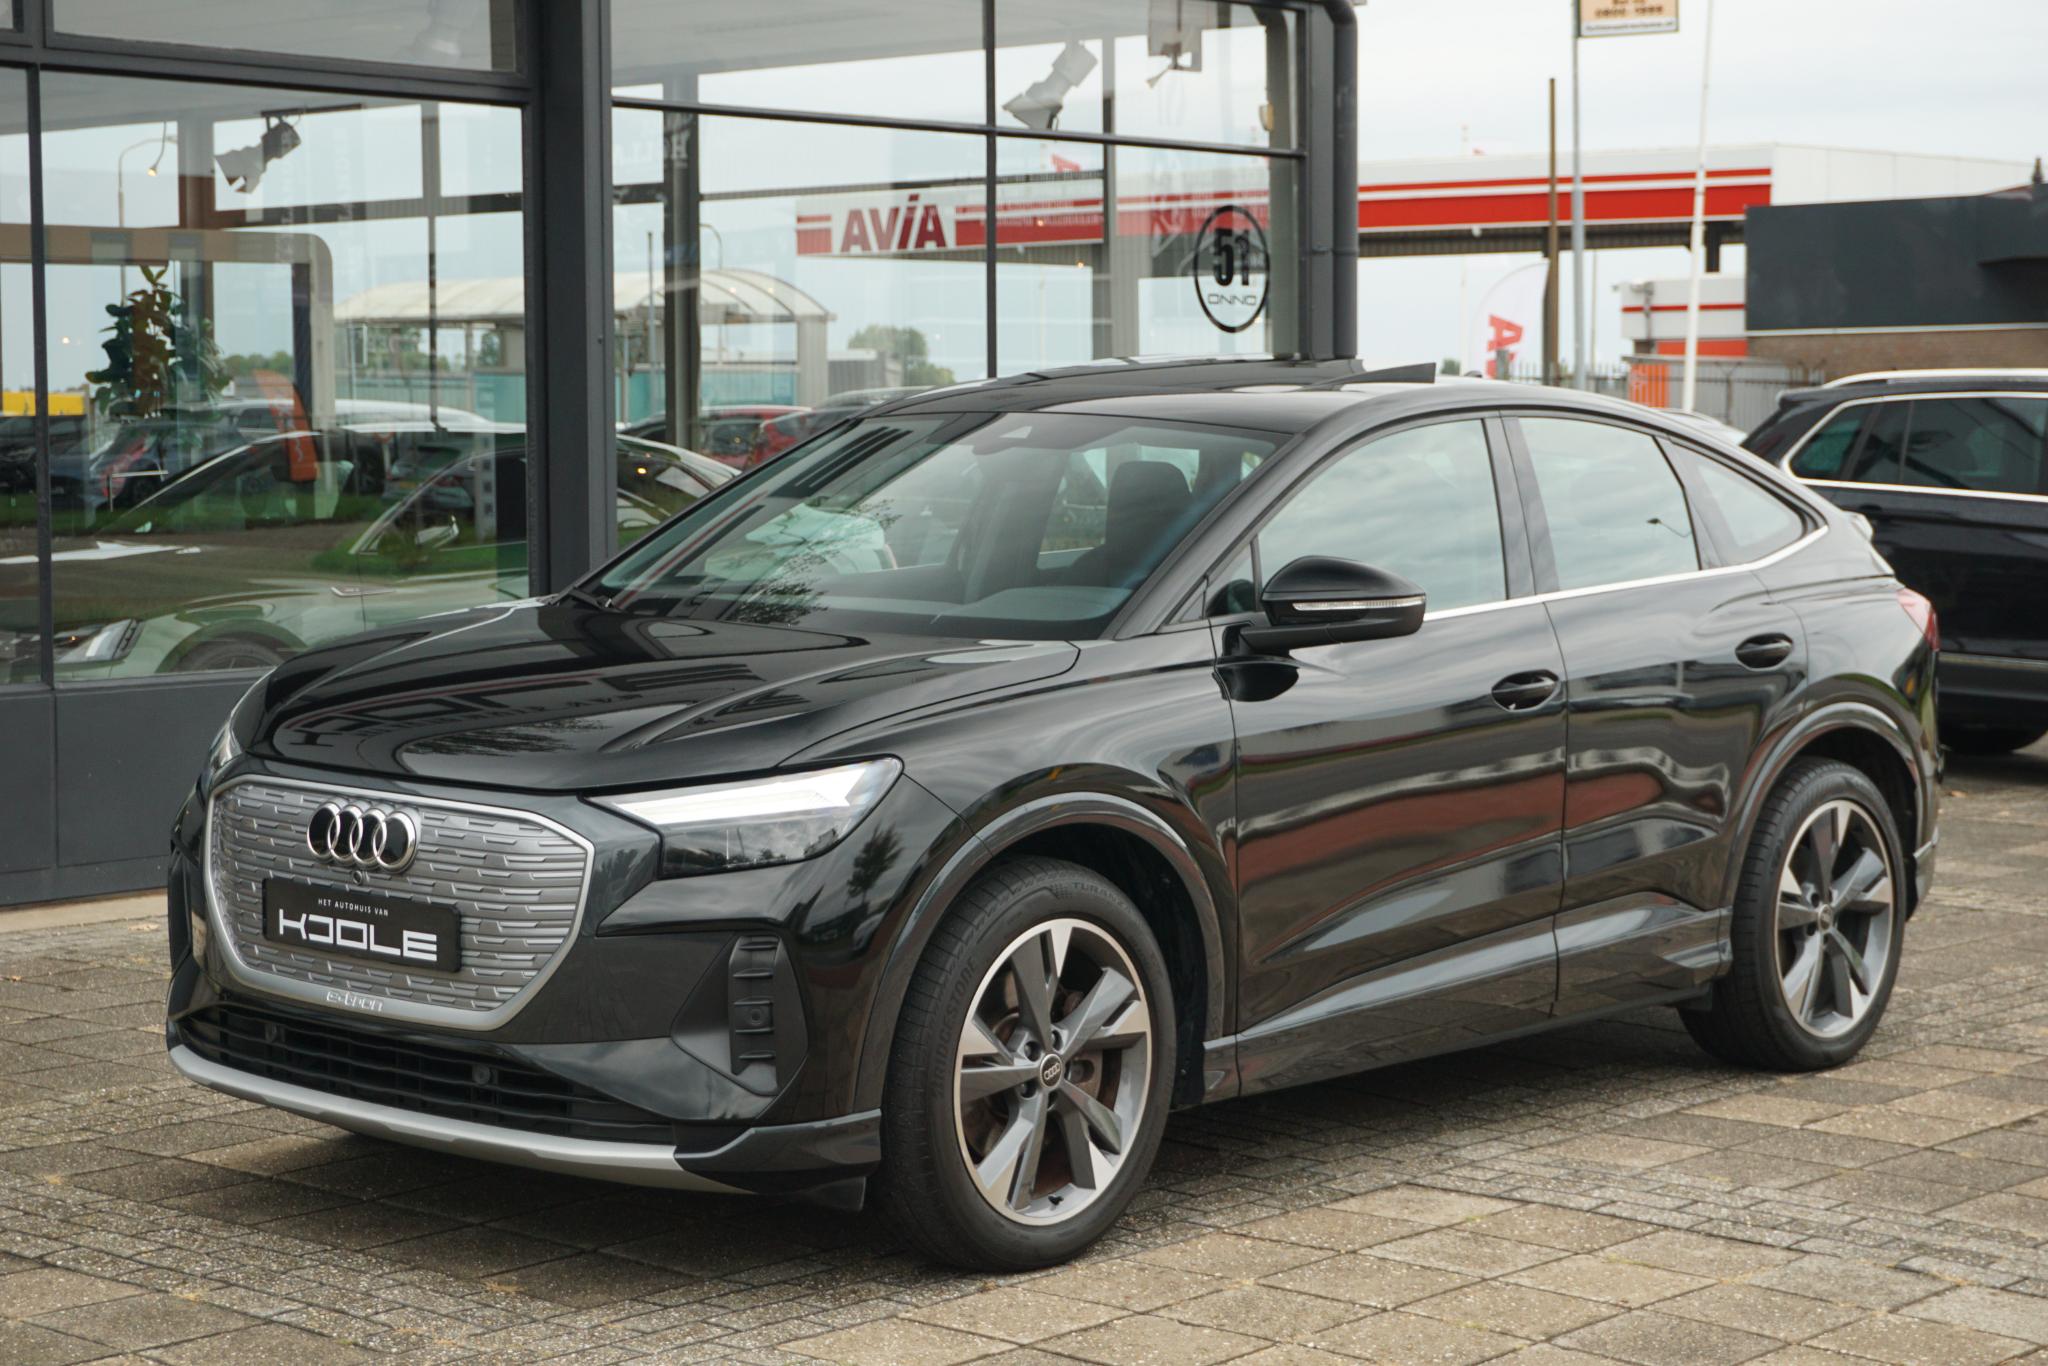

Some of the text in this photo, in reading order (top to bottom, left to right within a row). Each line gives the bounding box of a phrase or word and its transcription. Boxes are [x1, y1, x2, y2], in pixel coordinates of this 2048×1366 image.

[1213, 227, 1250, 286] 51
[318, 898, 389, 917] HET AUTOHUIS VAN
[278, 908, 438, 962] KOOLE
